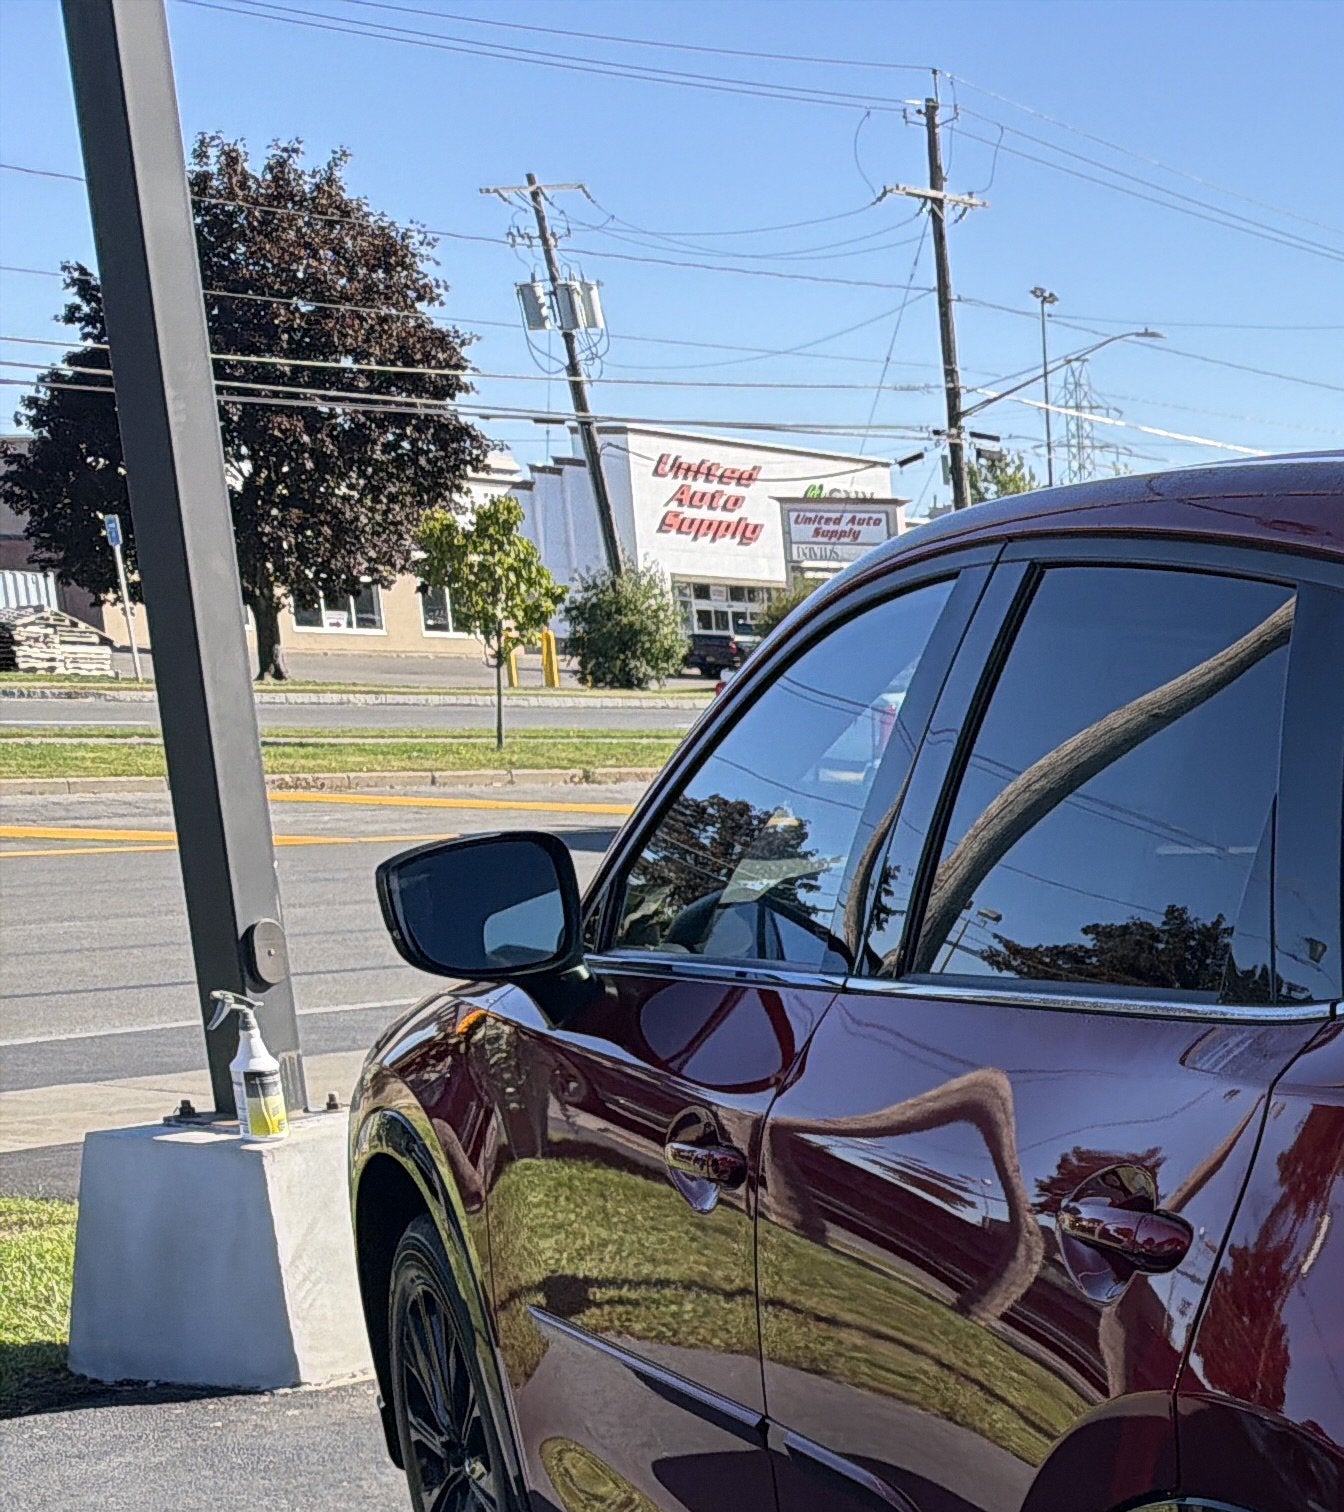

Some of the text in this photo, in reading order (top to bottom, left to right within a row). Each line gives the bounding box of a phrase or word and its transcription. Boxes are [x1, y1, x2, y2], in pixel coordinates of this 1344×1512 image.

[652, 453, 762, 488] United
[663, 484, 746, 513] Auto
[656, 510, 765, 546] Supply
[794, 513, 882, 527] United Auto
[811, 527, 861, 543] Supply
